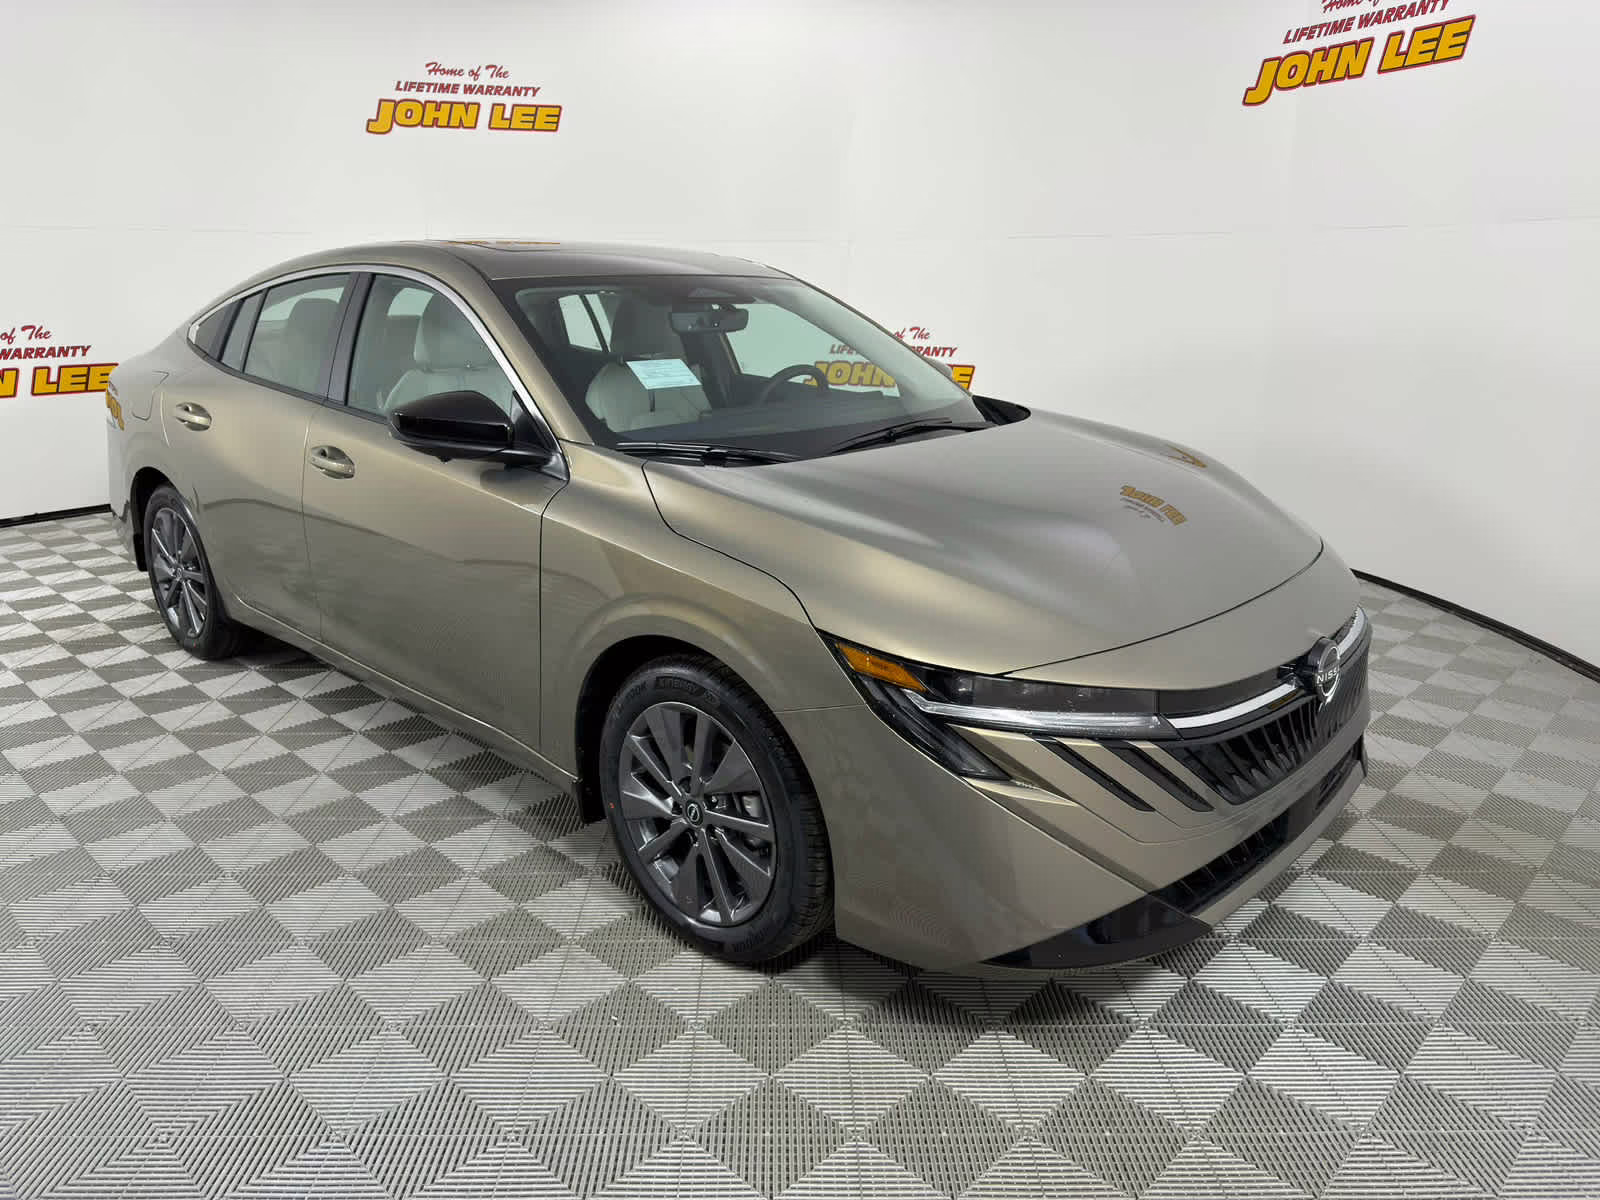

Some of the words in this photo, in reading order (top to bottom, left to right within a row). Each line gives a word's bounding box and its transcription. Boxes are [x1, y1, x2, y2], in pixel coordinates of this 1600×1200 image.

[1283, 16, 1355, 44] LIFETIME
[1357, 0, 1449, 29] WARRANTY
[1242, 37, 1375, 106] JOHN
[1377, 15, 1476, 74] LEE
[425, 62, 465, 77] Home
[468, 66, 481, 81] of
[485, 65, 510, 79] The
[395, 81, 460, 94] LIFETIME
[463, 83, 541, 97] WARRANTY
[366, 99, 480, 134] JOHN
[488, 103, 562, 133] LEE
[0, 327, 16, 344] of
[21, 325, 51, 340] The
[909, 326, 931, 340] The
[31, 363, 119, 397] LEE
[1316, 666, 1338, 684] NISS
